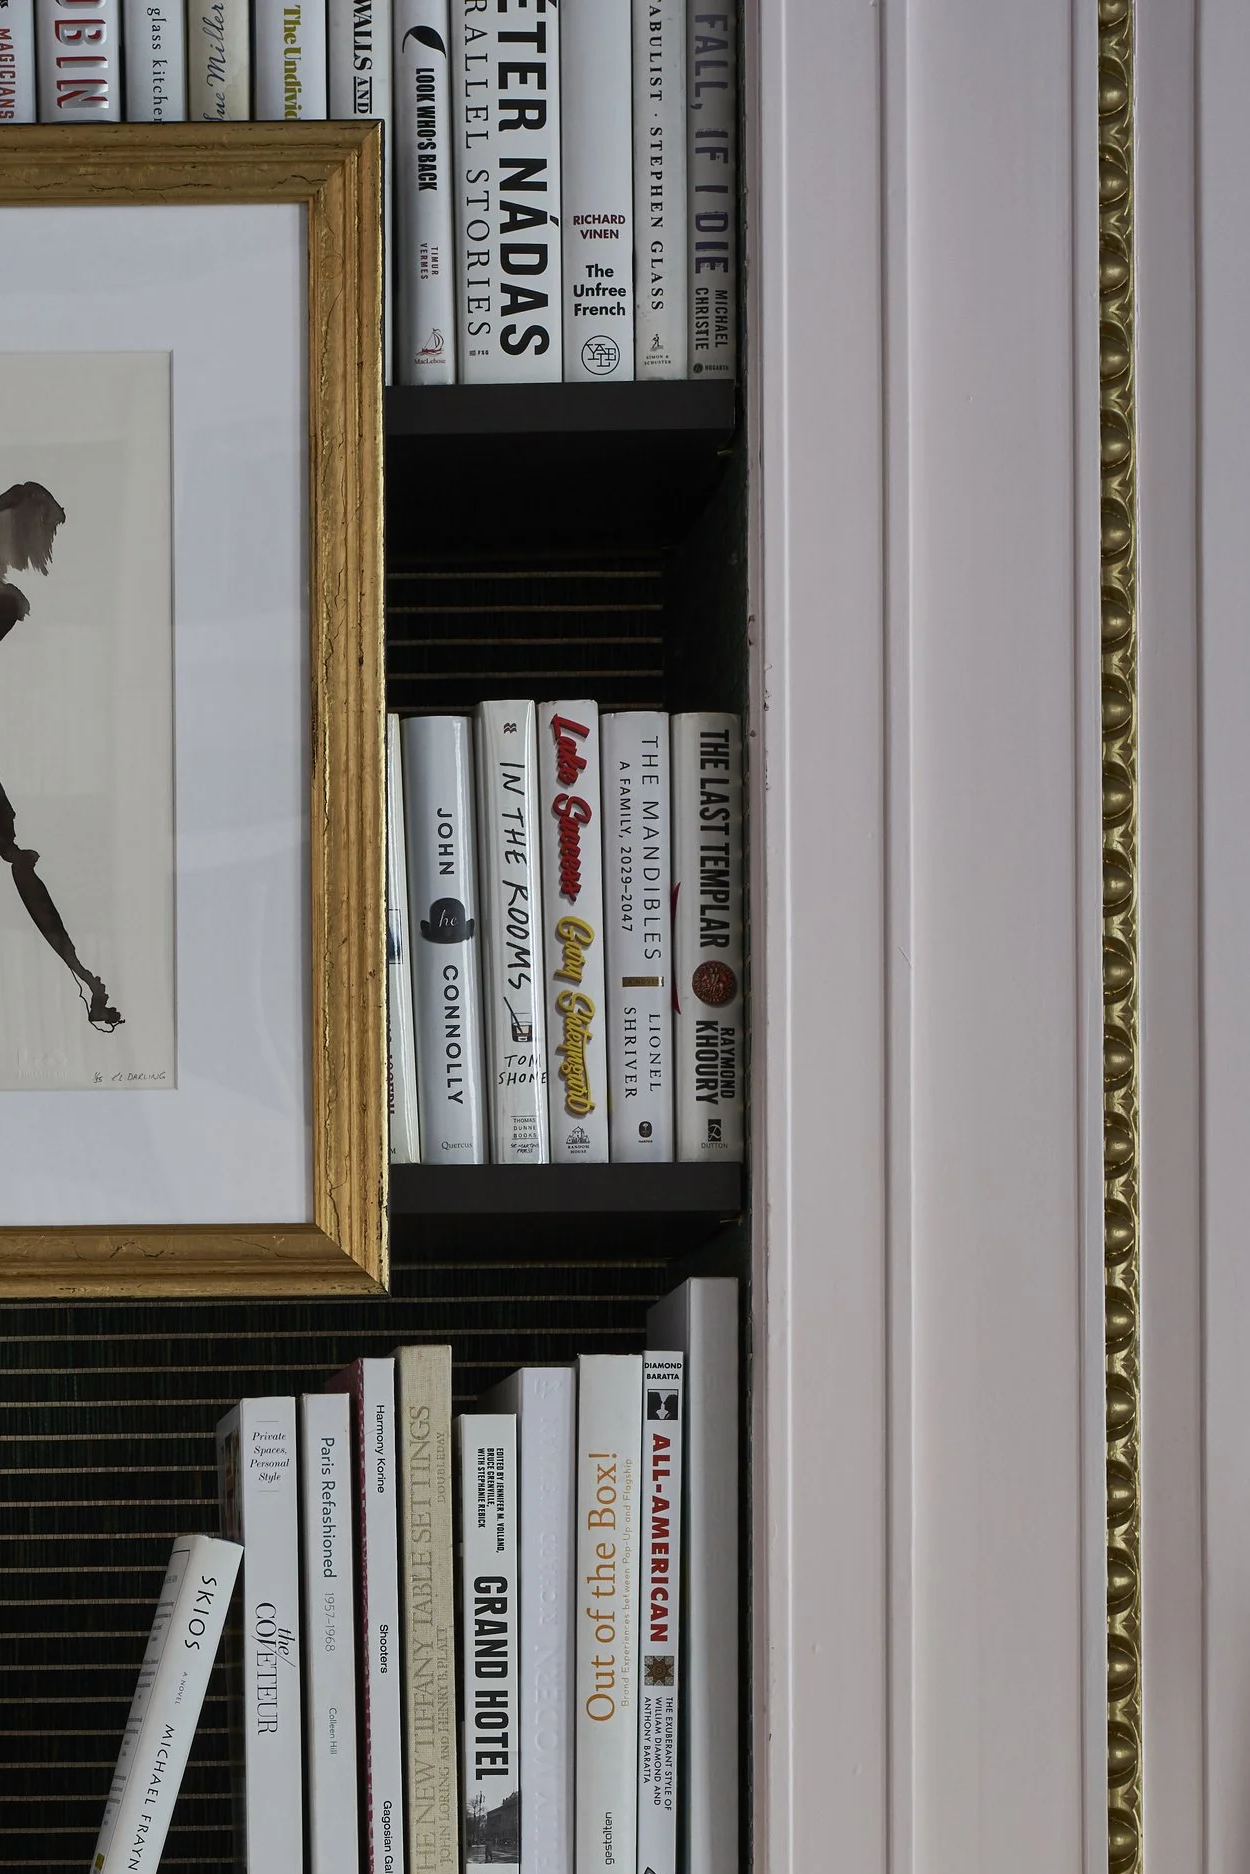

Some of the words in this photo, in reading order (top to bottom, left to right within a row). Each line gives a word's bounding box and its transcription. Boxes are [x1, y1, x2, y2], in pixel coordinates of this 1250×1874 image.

[416, 68, 435, 102] LOOK
[416, 106, 436, 151] WHO'S
[418, 155, 437, 191] BACK
[649, 127, 664, 228] STEPHEN
[573, 215, 626, 225] RICHARD
[580, 228, 619, 239] VINEN
[466, 169, 491, 336] STORIES
[499, 158, 558, 356] NÁDAS
[650, 241, 664, 310] GLASS
[573, 284, 627, 298] Unfree
[574, 303, 626, 316] French
[695, 287, 709, 350] CHRISTIE
[715, 290, 728, 348] MICHAEL
[550, 713, 590, 786] Lake
[700, 775, 728, 834] LAST
[437, 808, 454, 875] JOHN
[553, 794, 592, 903] Success
[642, 802, 661, 960] MANDIBLES
[699, 842, 729, 948] TEMPLAR
[442, 965, 463, 1104] CONNOLLY
[695, 1020, 719, 1106] KHOURY
[719, 1028, 735, 1099] RAYMOND
[498, 1071, 547, 1085] SHONE
[441, 1141, 473, 1150] Quercus
[252, 1432, 286, 1441] Private
[321, 1438, 335, 1475] Paris
[376, 1404, 384, 1455] Harmony
[249, 1459, 290, 1468] Personal
[258, 1472, 281, 1483] Style
[588, 1452, 618, 1530] Box!
[321, 1480, 337, 1578] Refashioned
[650, 1434, 670, 1642] ALL-AMERICAN
[586, 1542, 616, 1598] the
[185, 1575, 217, 1650] SKIOS
[474, 1575, 508, 1678] GRAND
[379, 1624, 388, 1673] Shooters
[586, 1655, 616, 1721] Out
[328, 1708, 337, 1740] Colleen
[474, 1690, 509, 1780] HOTEL
[643, 1697, 651, 1743] ANTHONY
[143, 1724, 175, 1805] MICHAEL
[127, 1814, 152, 1871] FRAYN
[382, 1800, 393, 1853] Gagosian
[603, 1811, 615, 1865] gestalten
